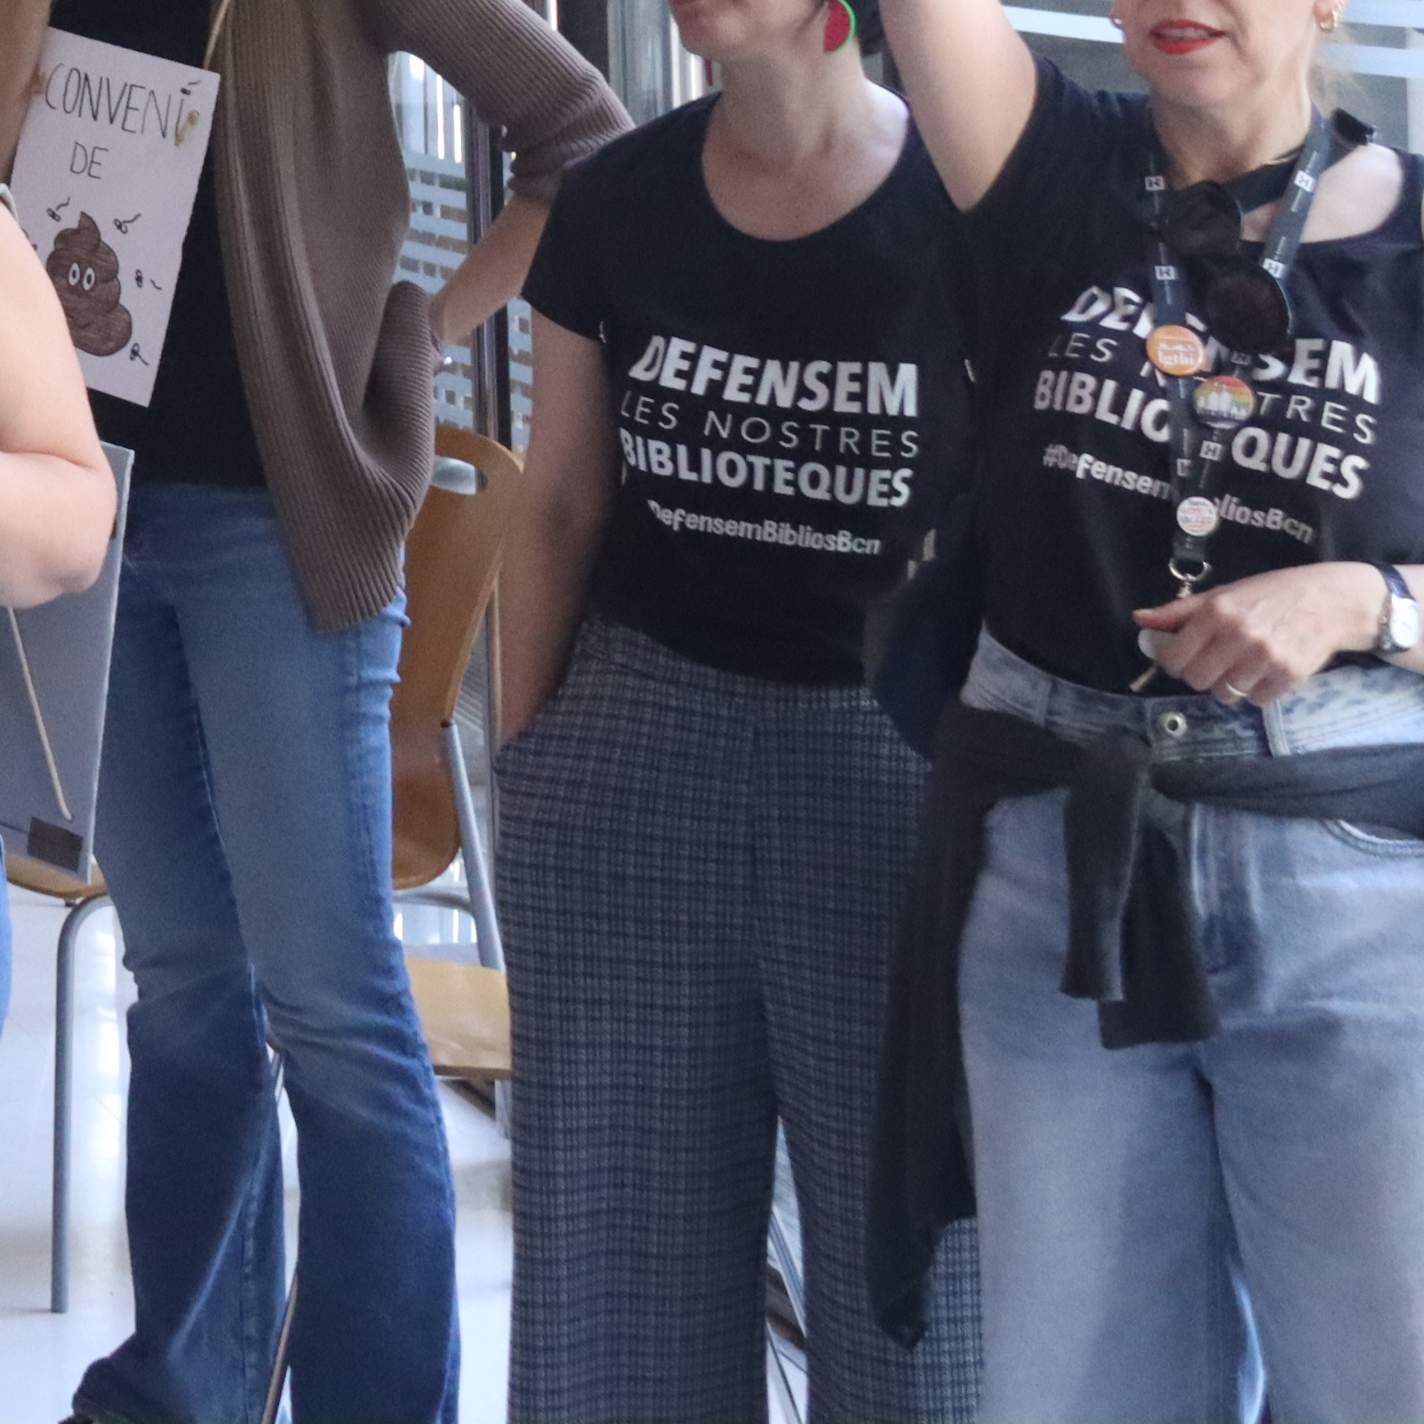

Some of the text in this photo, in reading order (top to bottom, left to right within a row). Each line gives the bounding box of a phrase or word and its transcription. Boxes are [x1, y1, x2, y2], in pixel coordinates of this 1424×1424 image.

[70, 141, 109, 179] DE
[629, 335, 918, 418] DEFENSEM
[620, 390, 920, 459] LES NOSTRES
[619, 427, 914, 507] BIBLIOTEQUES
